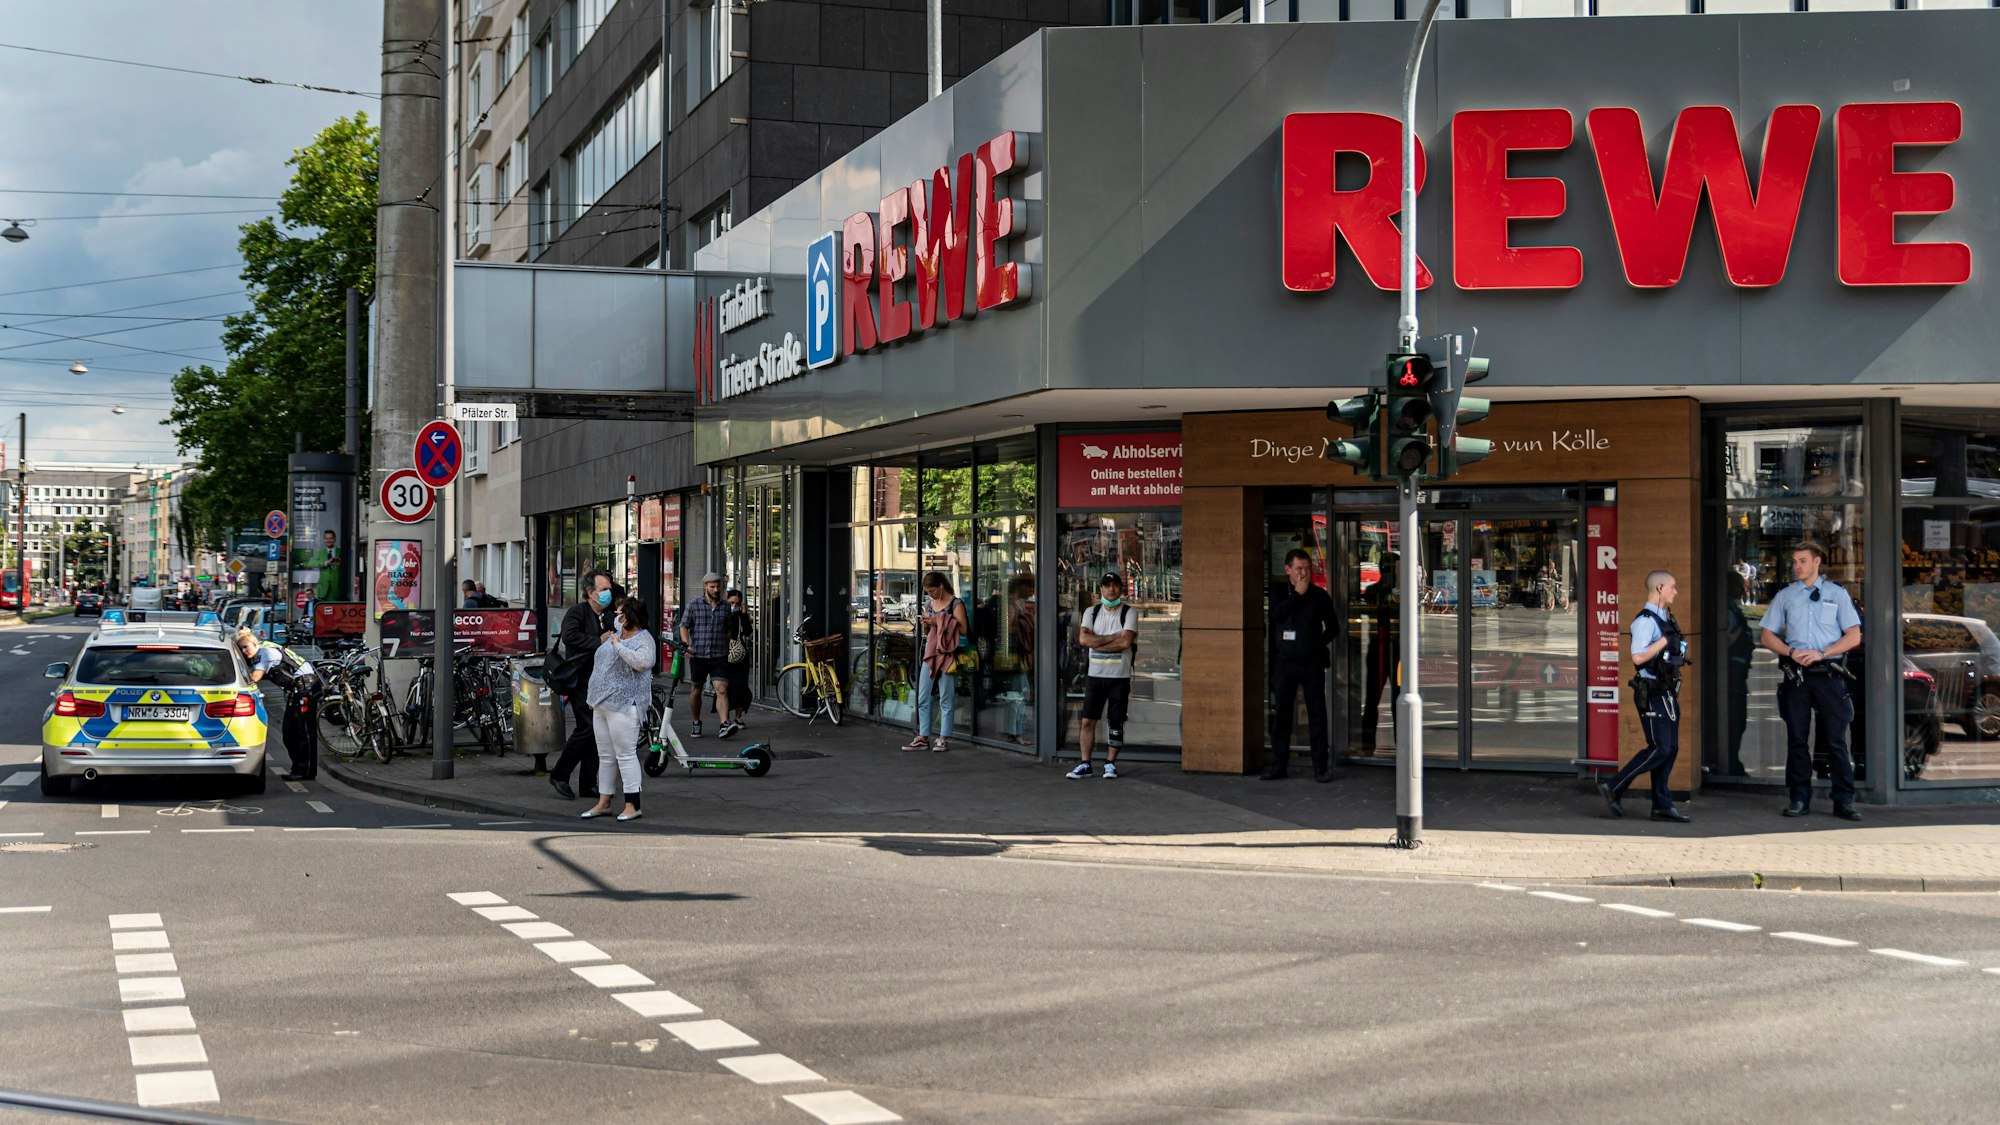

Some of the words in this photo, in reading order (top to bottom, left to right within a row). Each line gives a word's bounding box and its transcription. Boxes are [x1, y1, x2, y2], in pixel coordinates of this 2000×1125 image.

[1282, 101, 1972, 292] REWE
[843, 130, 1020, 356] REWE
[719, 276, 767, 334] Einfahrt
[720, 353, 759, 399] Trierer
[759, 331, 801, 387] Straße
[462, 407, 492, 418] Pfälzer
[495, 407, 510, 418] Str.
[1250, 438, 1315, 463] Dinge
[1503, 440, 1543, 452] vun
[1552, 429, 1610, 451] Kölle
[1091, 468, 1125, 480] Online
[1127, 467, 1176, 479] bestellen
[393, 484, 423, 508] 30
[1091, 487, 1106, 496] am
[1109, 484, 1141, 496] Markt
[376, 549, 401, 573] 50
[128, 708, 148, 718] NRW
